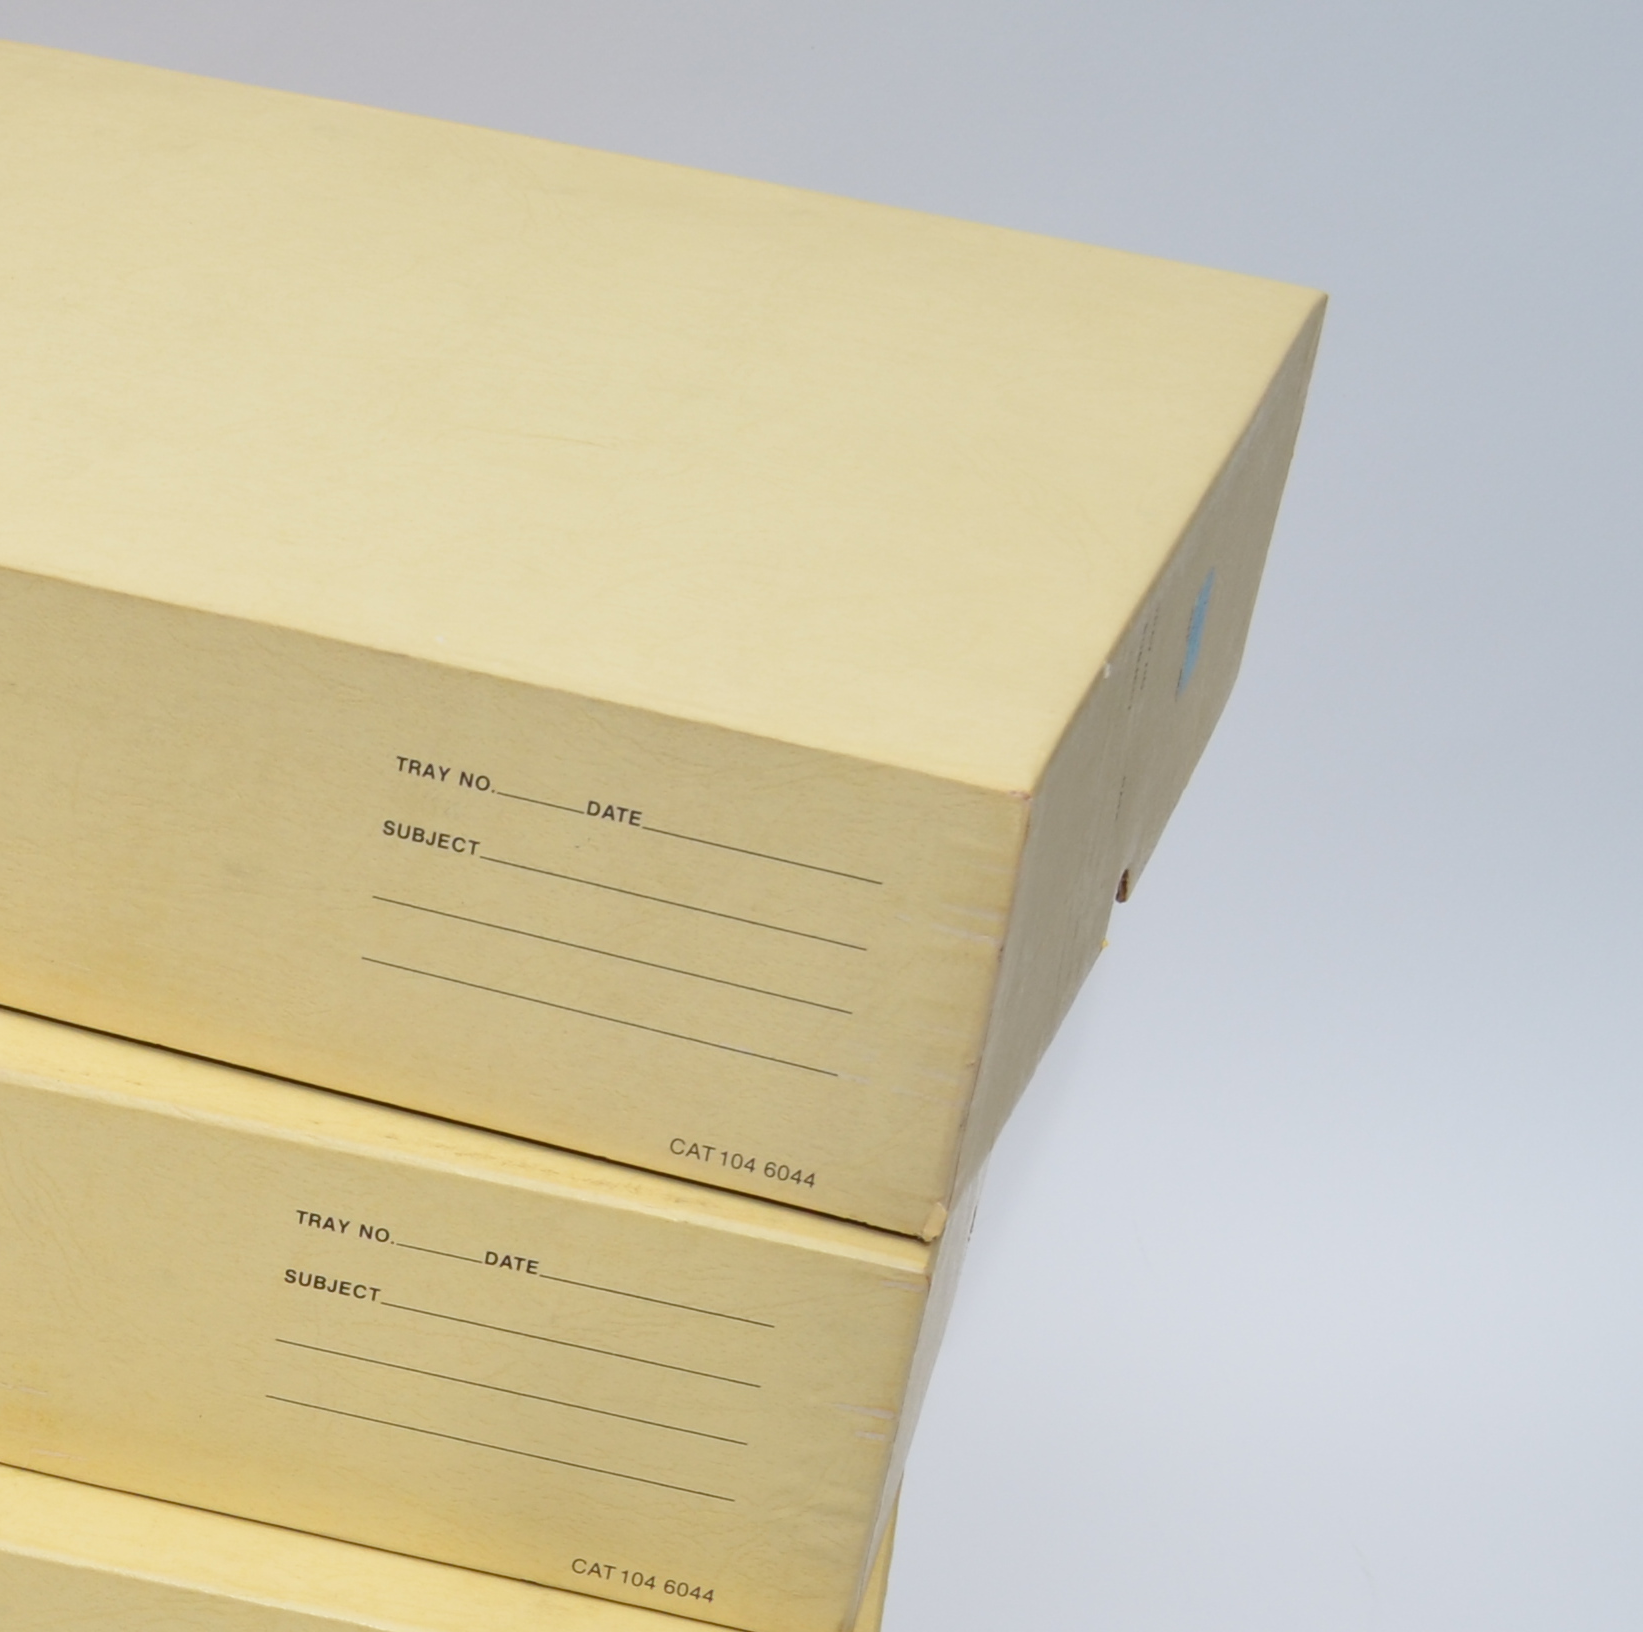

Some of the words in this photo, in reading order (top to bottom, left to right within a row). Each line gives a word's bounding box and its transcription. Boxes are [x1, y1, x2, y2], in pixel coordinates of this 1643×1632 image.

[396, 756, 450, 783] TRAY
[460, 772, 496, 794] NO.
[587, 801, 642, 827] DATE
[383, 820, 480, 856] SUBJECT
[670, 1138, 715, 1162] CAT
[720, 1151, 756, 1173] 104
[764, 1161, 816, 1188] 6044
[296, 1209, 350, 1235] TRAY
[359, 1224, 396, 1245] NO.
[484, 1250, 540, 1276] DATE
[284, 1268, 381, 1302] SUBJECT
[572, 1558, 616, 1581] CAT
[620, 1569, 656, 1590] 104
[664, 1579, 715, 1603] 6044
